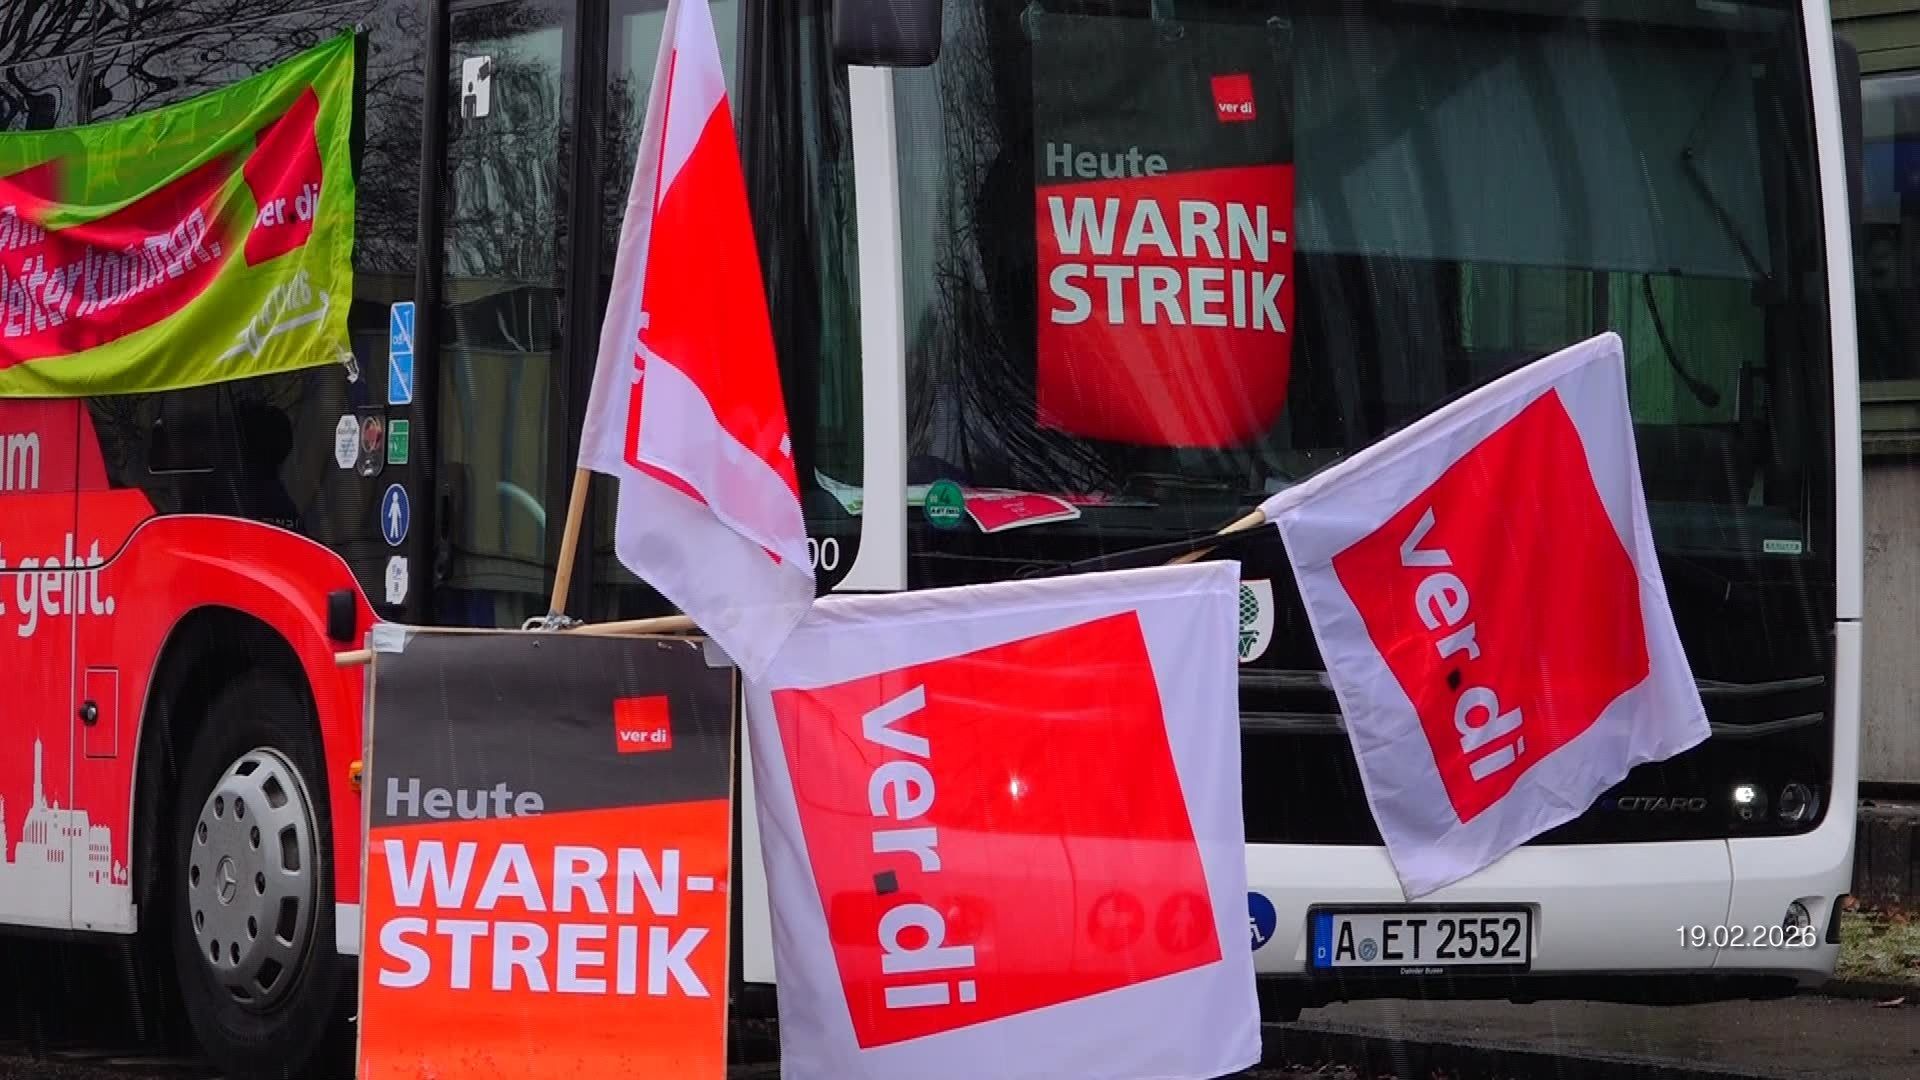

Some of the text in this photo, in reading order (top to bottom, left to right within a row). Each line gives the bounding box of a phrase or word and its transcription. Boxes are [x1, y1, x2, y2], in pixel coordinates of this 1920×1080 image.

[1046, 143, 1168, 178] Heute
[1048, 196, 1287, 263] WARN-
[1049, 264, 1287, 333] STREIK
[17, 533, 115, 637] geht.
[386, 777, 544, 819] Heute
[1617, 797, 1708, 811] CITARO
[384, 839, 714, 916] WARN-
[379, 917, 711, 997] STREIK
[1335, 918, 1521, 961] A ET 2552
